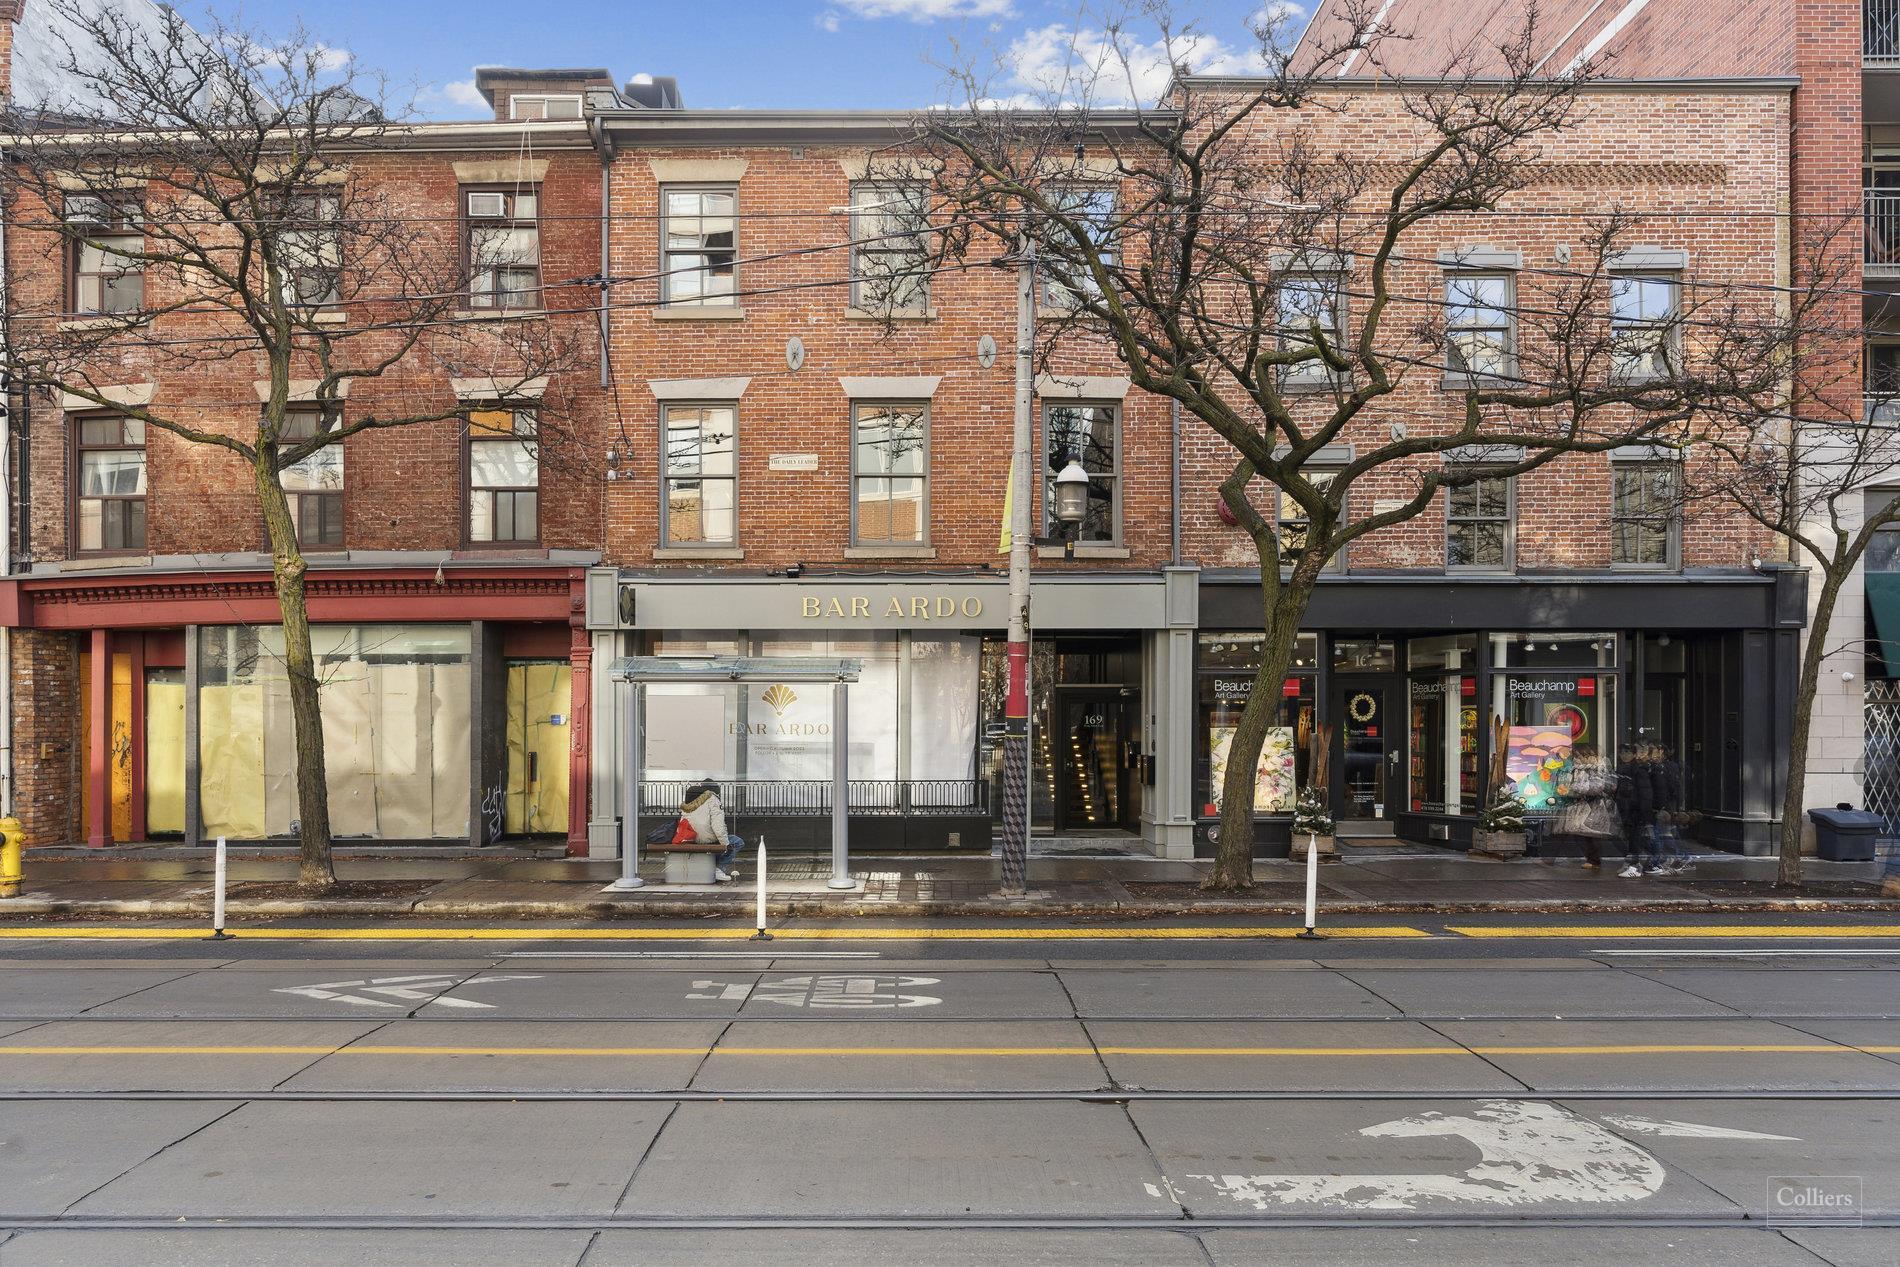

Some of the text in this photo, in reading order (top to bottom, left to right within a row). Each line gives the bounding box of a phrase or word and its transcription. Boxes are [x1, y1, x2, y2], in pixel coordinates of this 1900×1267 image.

[802, 596, 984, 620] BAR ARDO
[1214, 680, 1254, 692] Beauch
[1509, 679, 1575, 693] Beauchamp
[1226, 692, 1249, 701] Gallery
[1521, 692, 1545, 700] Gallery
[1085, 715, 1103, 724] 169
[775, 723, 830, 737] ARDO
